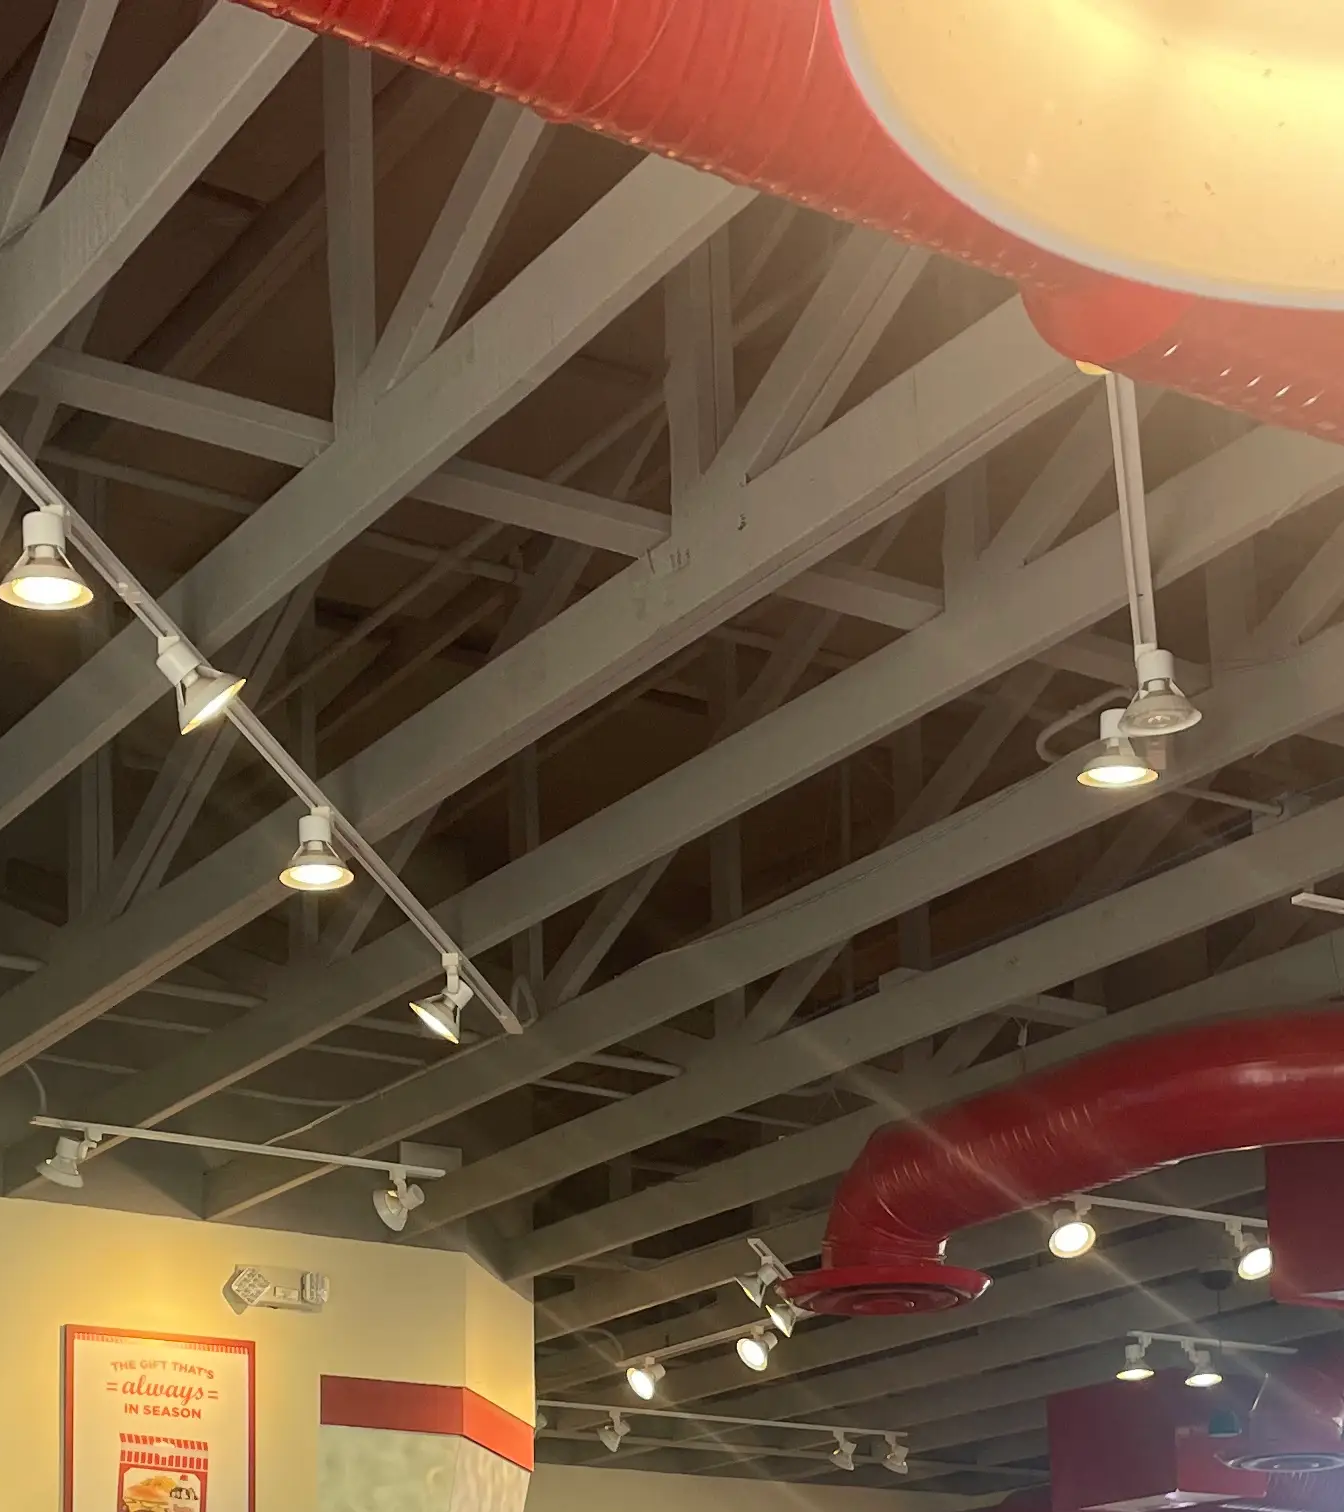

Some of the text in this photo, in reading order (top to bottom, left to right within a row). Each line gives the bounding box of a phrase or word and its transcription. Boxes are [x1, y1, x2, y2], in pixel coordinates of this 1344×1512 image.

[110, 1359, 215, 1380] THE GIFT THAT'S
[122, 1374, 204, 1406] always
[124, 1403, 202, 1420] IN SEASON
